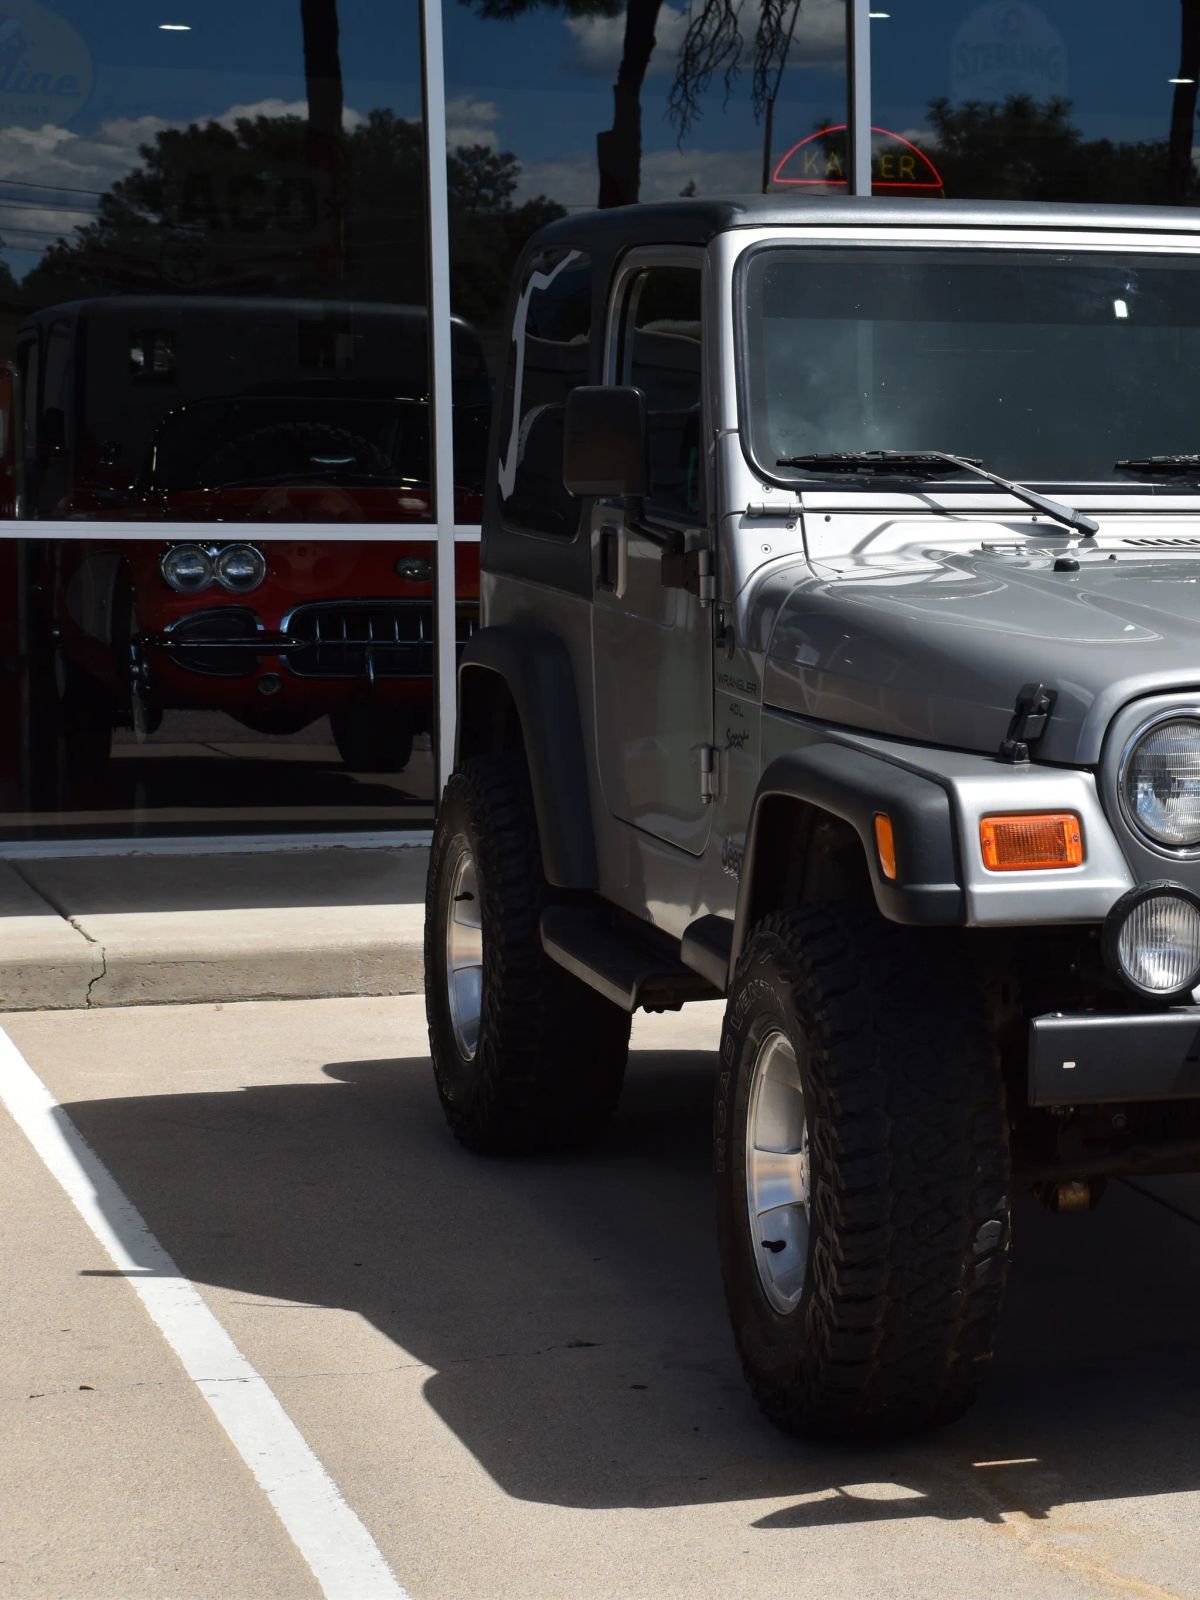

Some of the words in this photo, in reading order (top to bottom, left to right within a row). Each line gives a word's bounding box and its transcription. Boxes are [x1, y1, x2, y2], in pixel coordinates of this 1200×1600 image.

[802, 150, 917, 180] KAER
[717, 671, 758, 696] WRANGLER
[725, 727, 750, 750] Sport
